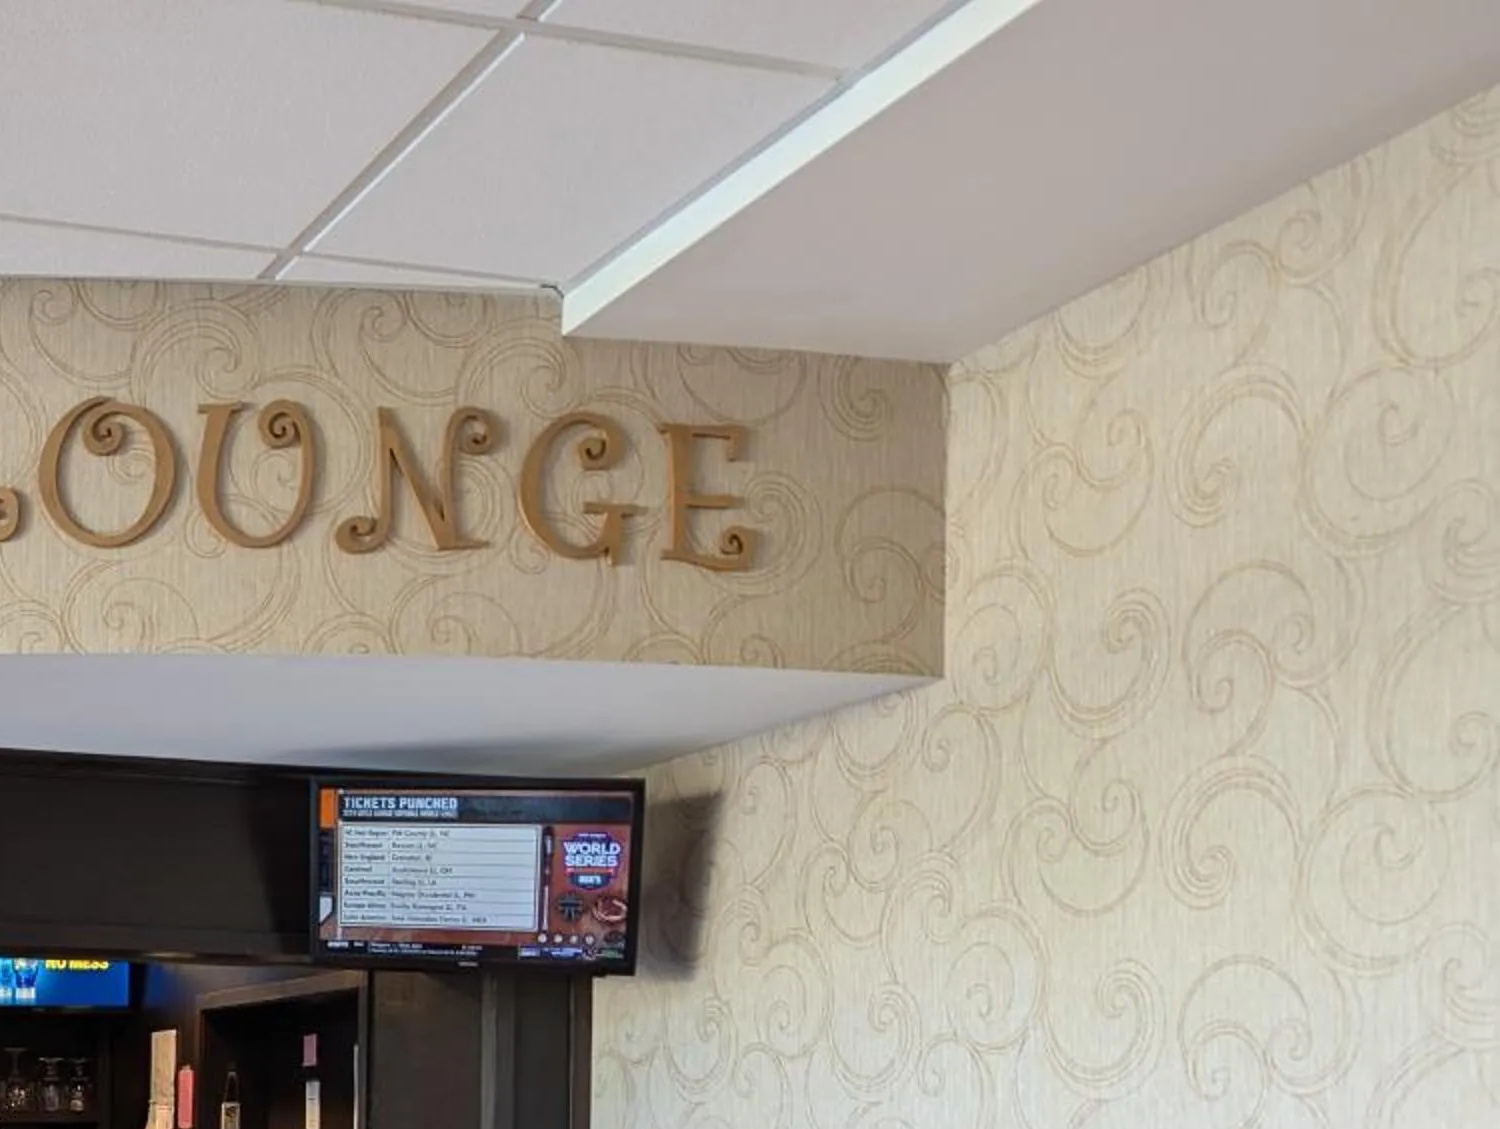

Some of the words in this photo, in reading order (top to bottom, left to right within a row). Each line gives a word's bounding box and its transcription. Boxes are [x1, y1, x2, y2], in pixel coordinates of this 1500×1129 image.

[344, 797, 396, 809] TICKETS
[400, 797, 458, 810] PUNCHED
[563, 841, 621, 856] WORLD
[564, 855, 619, 868] SERIES
